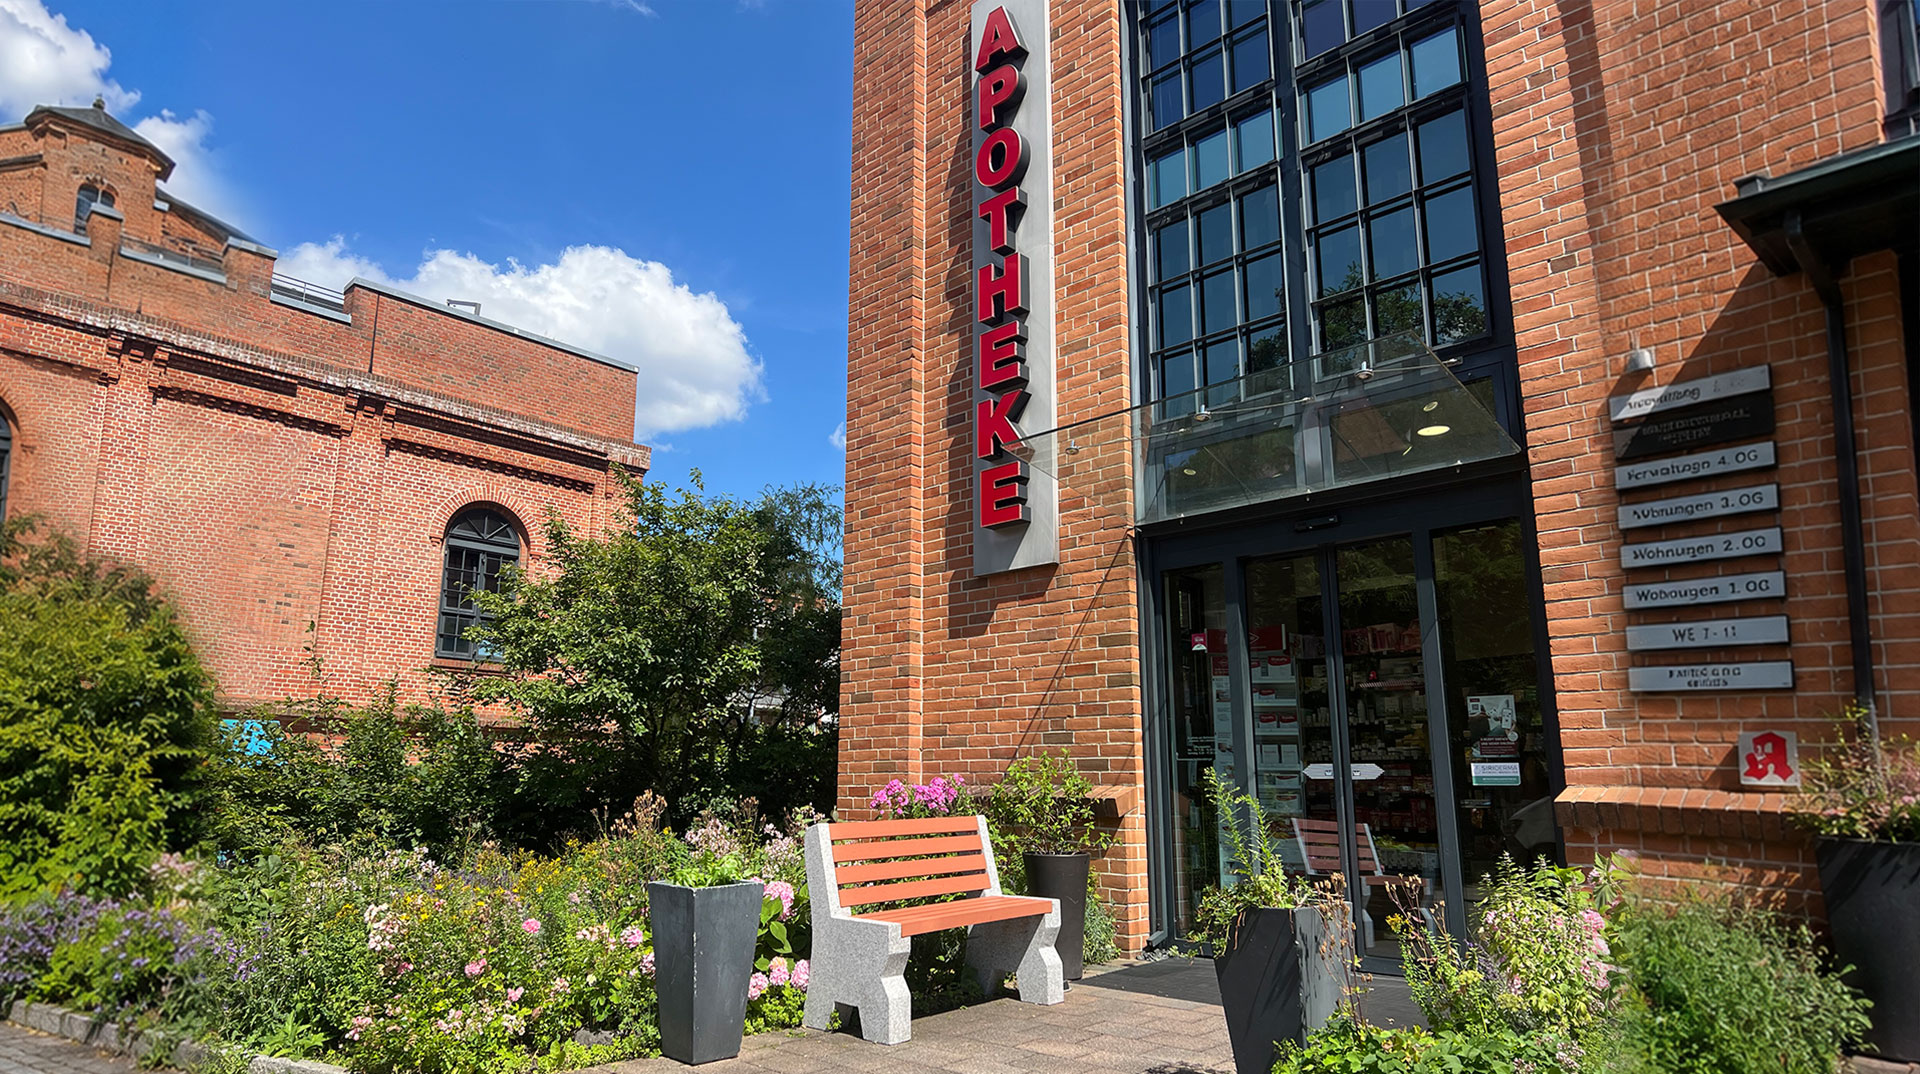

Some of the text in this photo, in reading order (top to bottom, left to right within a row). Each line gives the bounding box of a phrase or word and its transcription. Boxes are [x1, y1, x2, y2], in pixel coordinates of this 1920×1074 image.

[974, 5, 1031, 530] APOTHEKE
[1735, 449, 1759, 464] OG
[1739, 491, 1764, 506] OG
[1745, 579, 1770, 593] OG
[1672, 627, 1696, 642] WE
